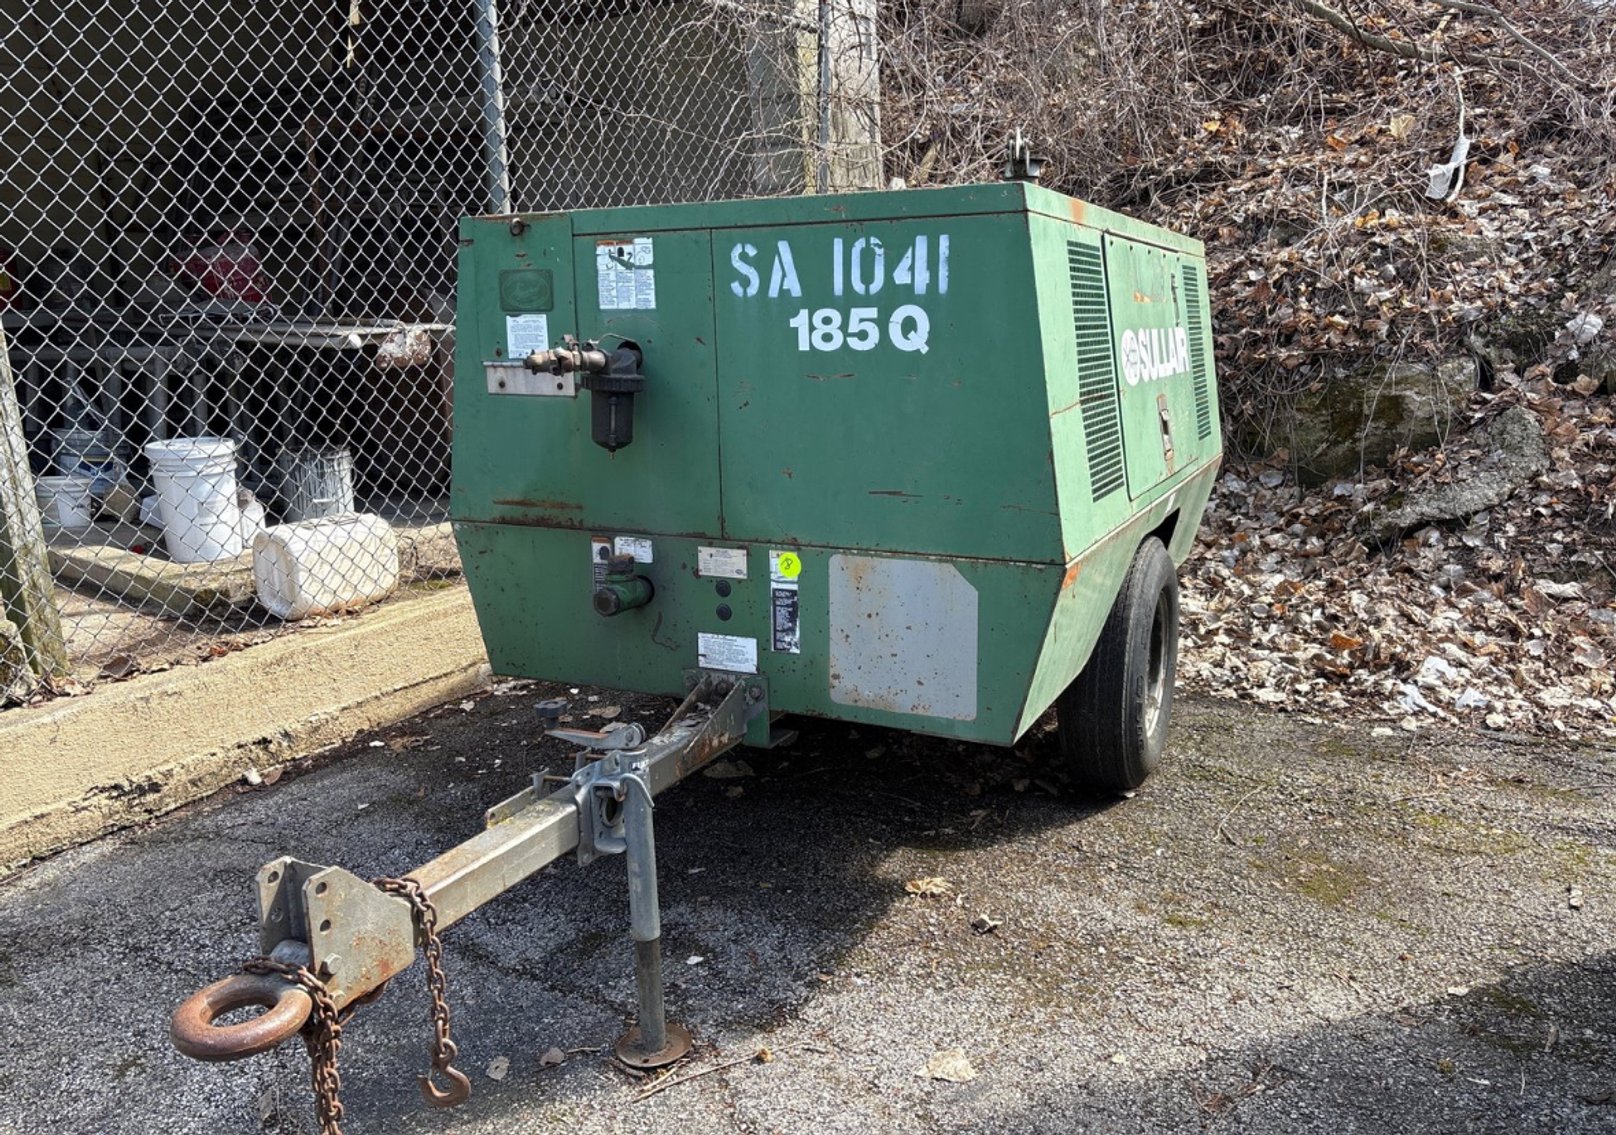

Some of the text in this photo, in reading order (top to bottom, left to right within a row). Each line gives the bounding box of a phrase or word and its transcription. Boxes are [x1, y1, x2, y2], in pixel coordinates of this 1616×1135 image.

[730, 234, 950, 298] SA 1041
[1138, 327, 1190, 382] SULLAIR
